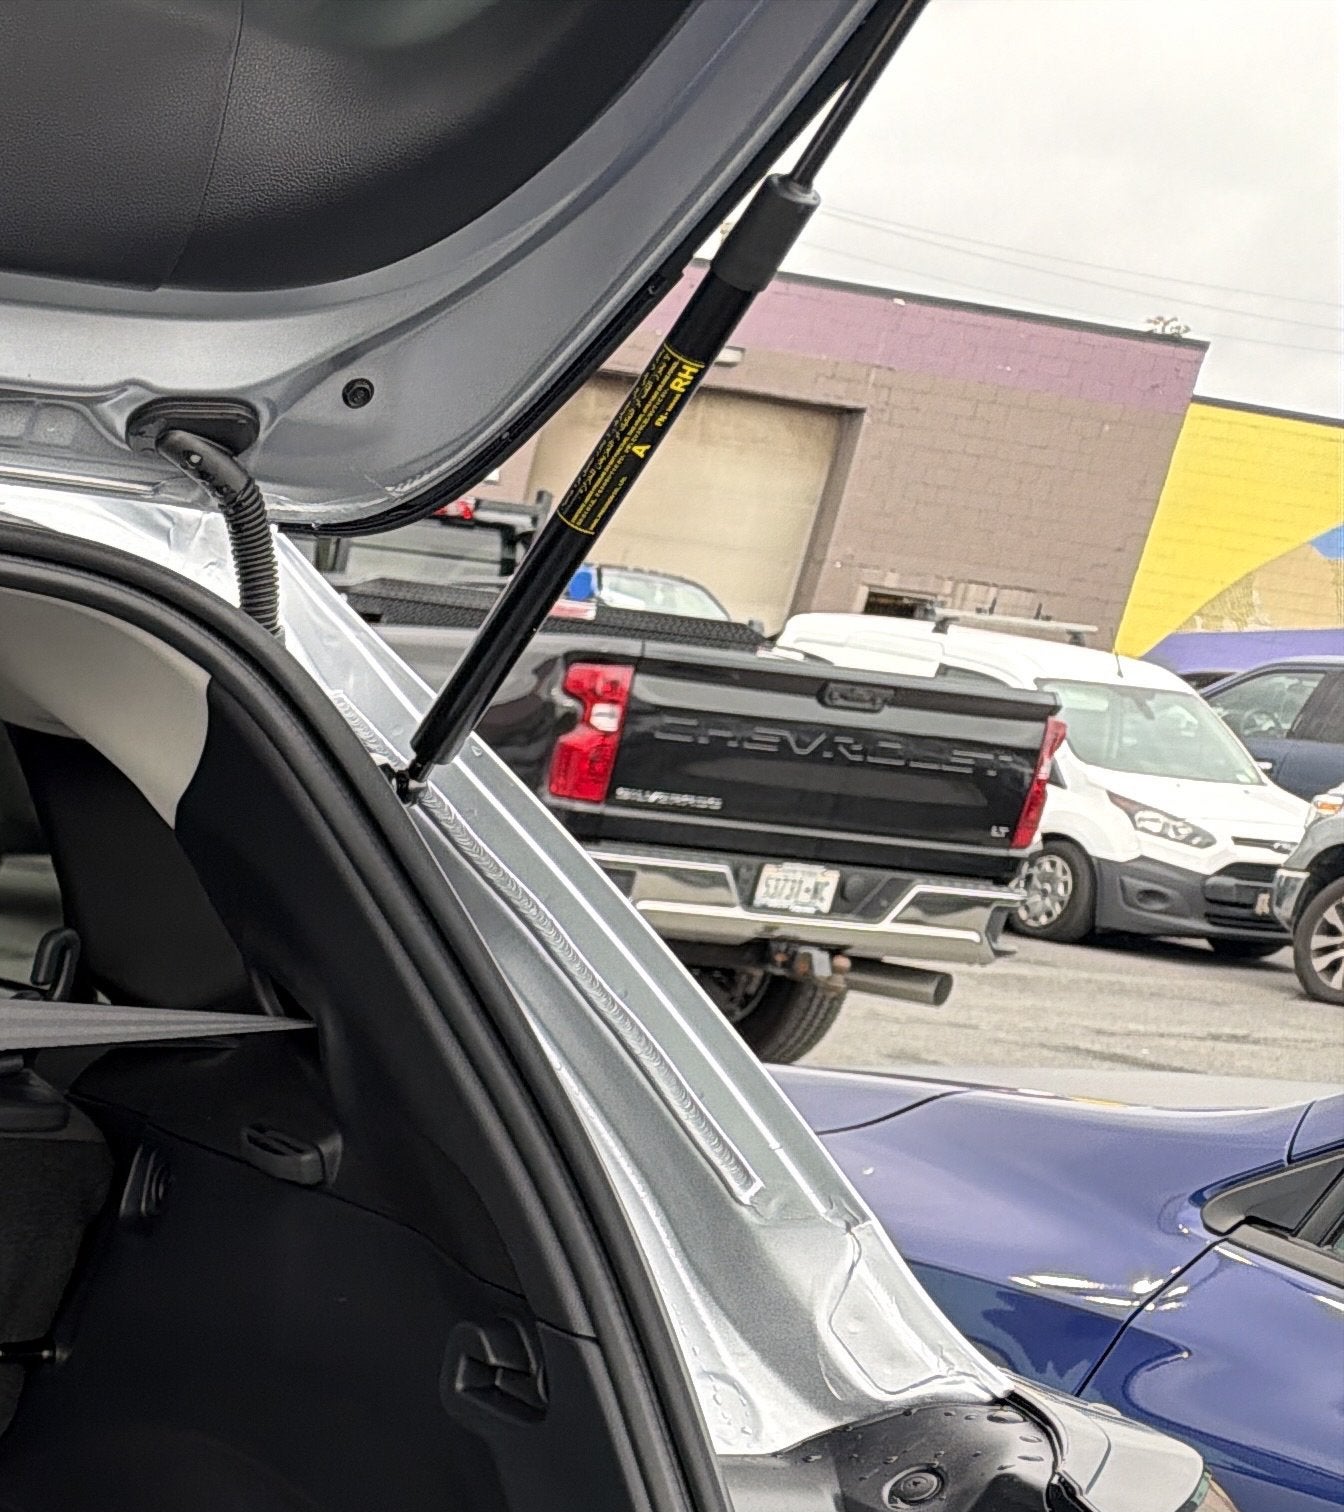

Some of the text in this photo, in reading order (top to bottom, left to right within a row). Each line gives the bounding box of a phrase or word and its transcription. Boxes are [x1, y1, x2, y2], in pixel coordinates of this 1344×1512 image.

[669, 364, 700, 393] RH
[631, 444, 652, 459] A
[654, 716, 1014, 777] CHEVROLET
